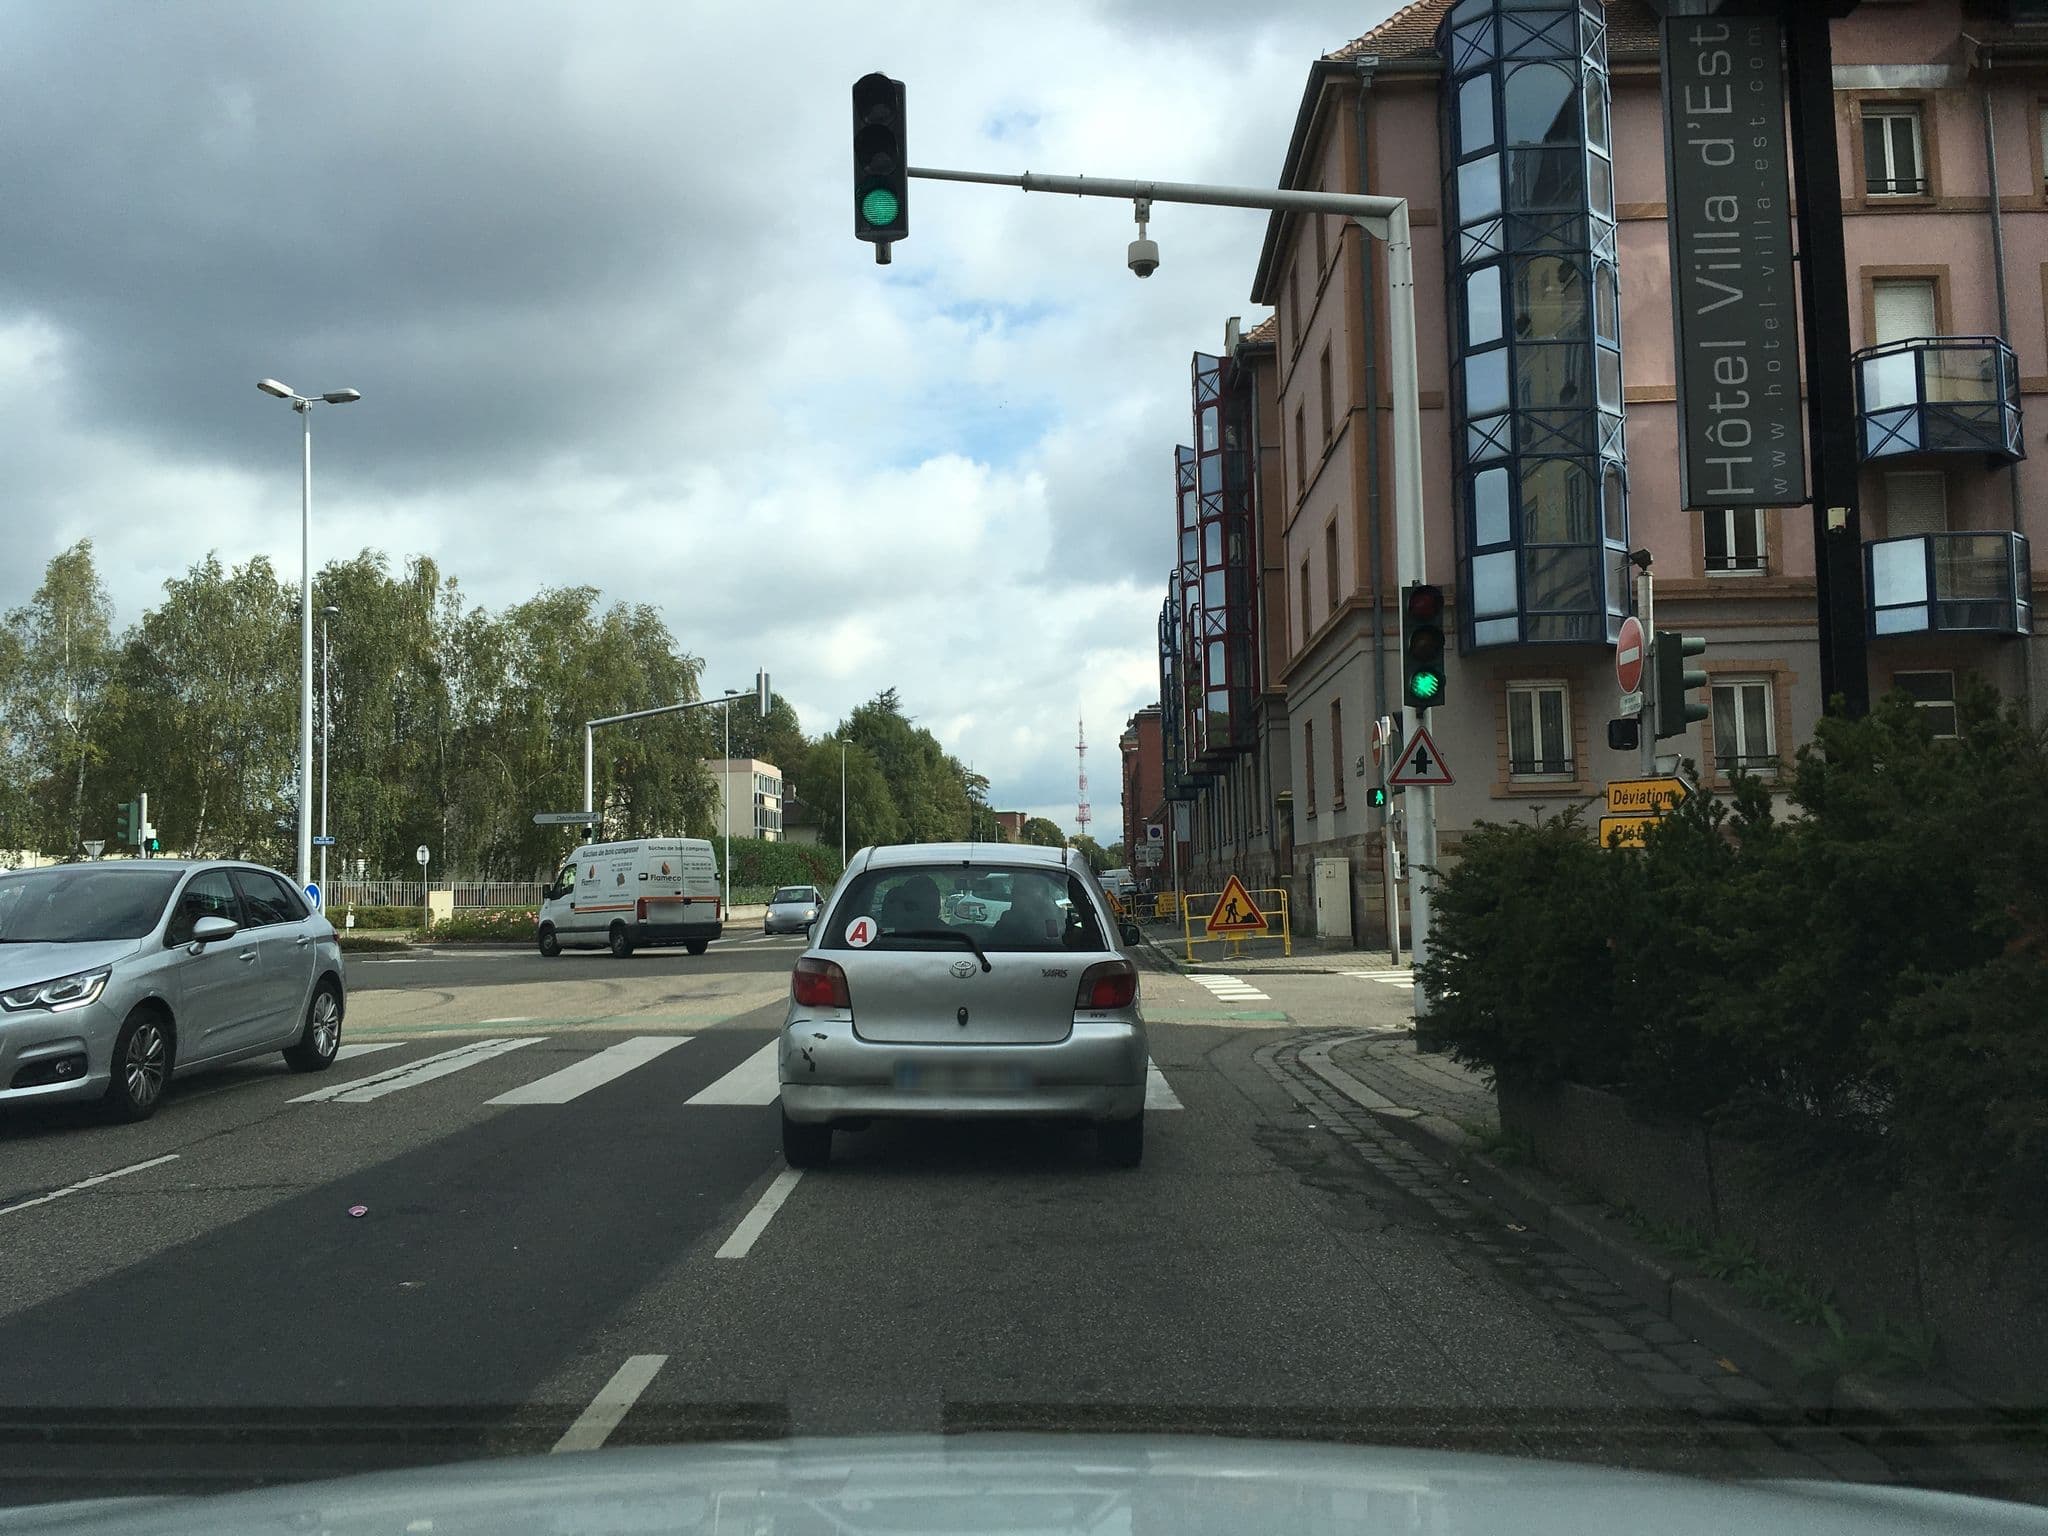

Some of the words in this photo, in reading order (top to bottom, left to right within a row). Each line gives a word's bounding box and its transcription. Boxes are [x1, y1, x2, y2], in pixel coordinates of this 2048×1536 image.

[1686, 22, 1735, 167] d'Est
[1693, 194, 1745, 316] Villa
[1749, 25, 1789, 497] www.hotel-villa-est.com
[1700, 340, 1755, 497] Hôtel
[1613, 787, 1672, 805] Déviation
[650, 874, 682, 882] Flameco
[848, 921, 868, 943] A
